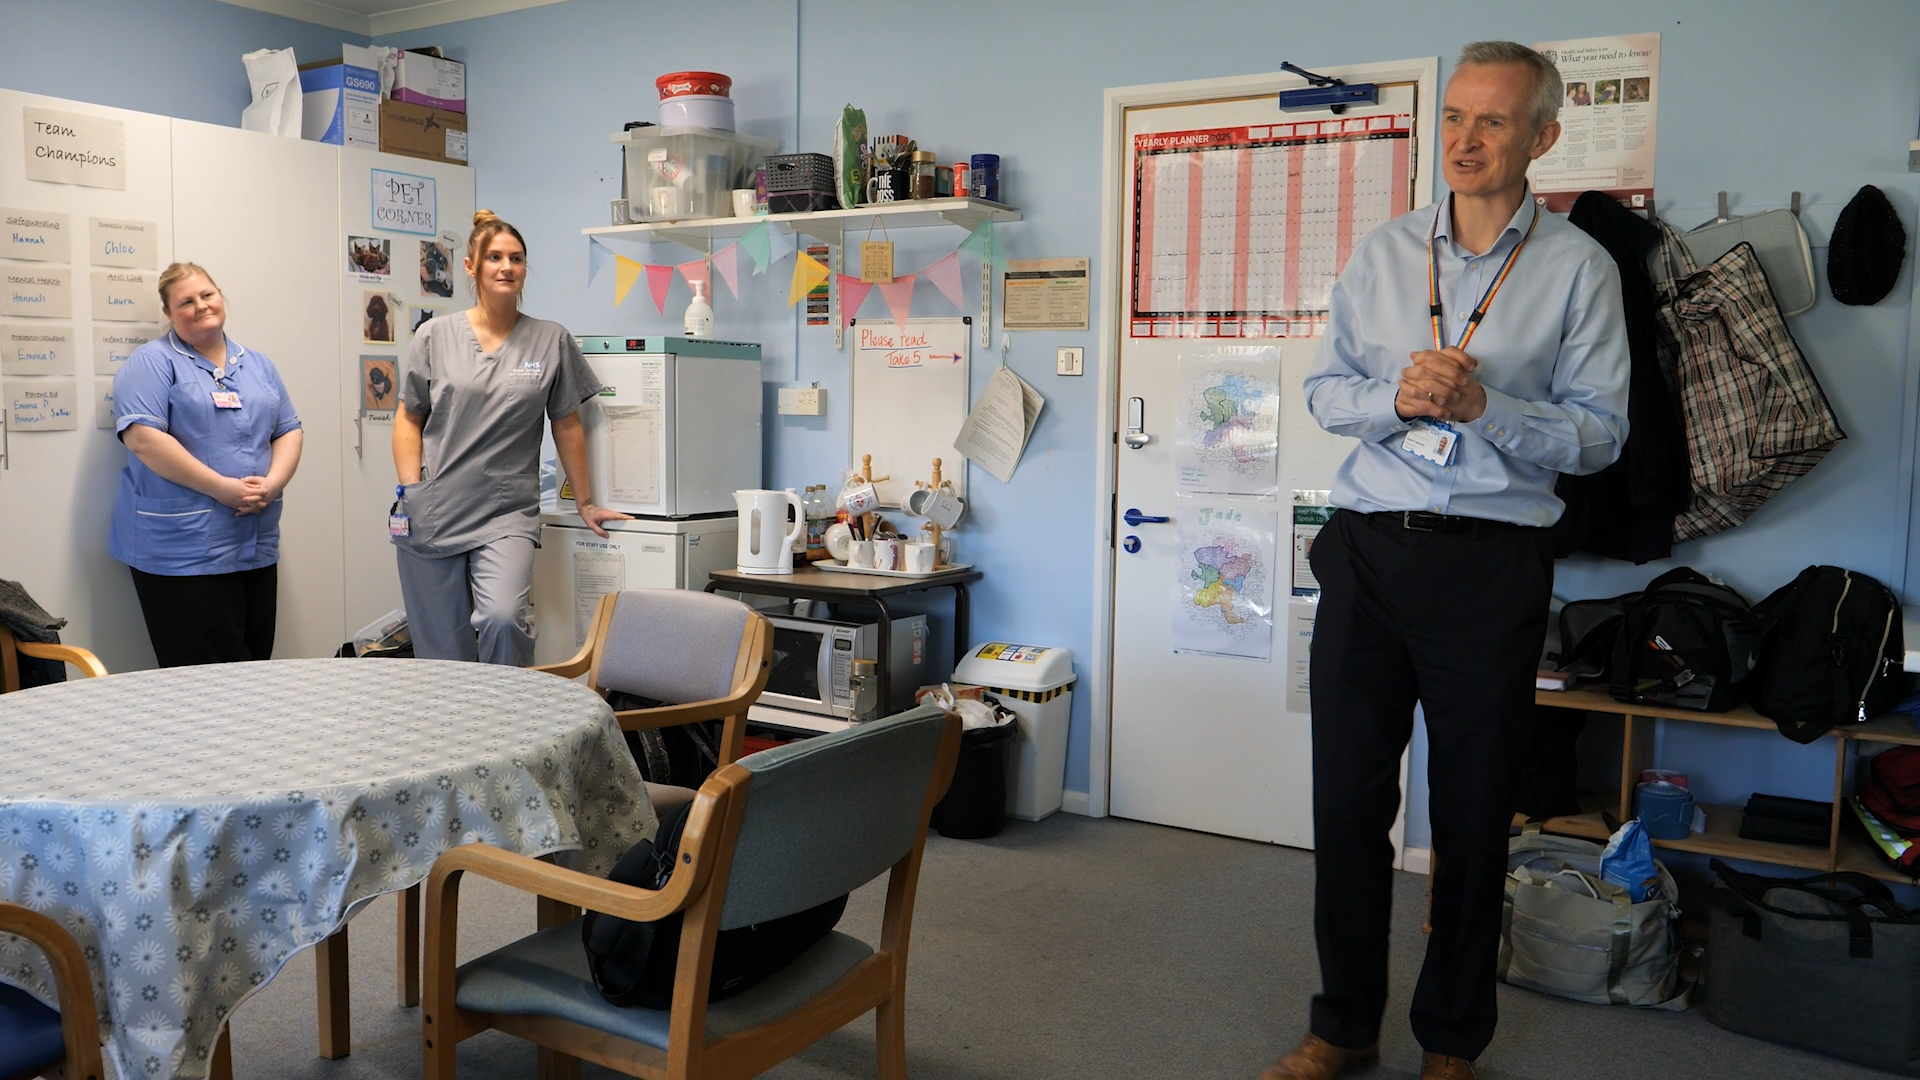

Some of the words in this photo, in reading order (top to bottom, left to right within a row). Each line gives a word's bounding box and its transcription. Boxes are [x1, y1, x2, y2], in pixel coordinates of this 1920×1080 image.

[1561, 54, 1581, 63] What
[1582, 55, 1597, 64] you
[1598, 50, 1616, 60] need
[1628, 49, 1652, 57] know
[345, 76, 375, 90] GS690
[34, 121, 76, 137] Team
[1137, 137, 1168, 148] YEARLY
[1170, 134, 1209, 145] PLANNER
[1211, 133, 1231, 142] 2025
[35, 146, 116, 168] Champions
[854, 170, 860, 180] 5
[878, 172, 892, 190] THE
[386, 178, 424, 206] PET
[377, 205, 433, 228] CORNER
[613, 205, 625, 222] N
[6, 217, 60, 230] Safeguarding
[12, 233, 45, 244] Hannah
[104, 241, 135, 254] Chloe
[8, 276, 35, 284] Mental
[37, 278, 61, 286] Health
[12, 292, 46, 303] Hannah
[108, 295, 135, 305] Laura
[102, 336, 123, 344] Infant
[861, 329, 894, 347] Please
[900, 332, 928, 347] read
[18, 349, 47, 360] Emma
[49, 351, 56, 360] D
[109, 352, 130, 362] Emm
[884, 350, 910, 366] Take
[913, 350, 921, 363] 5
[14, 400, 38, 410] Emma
[14, 414, 46, 423] Hannah
[1198, 508, 1242, 526] Jade
[1316, 515, 1324, 523] Up
